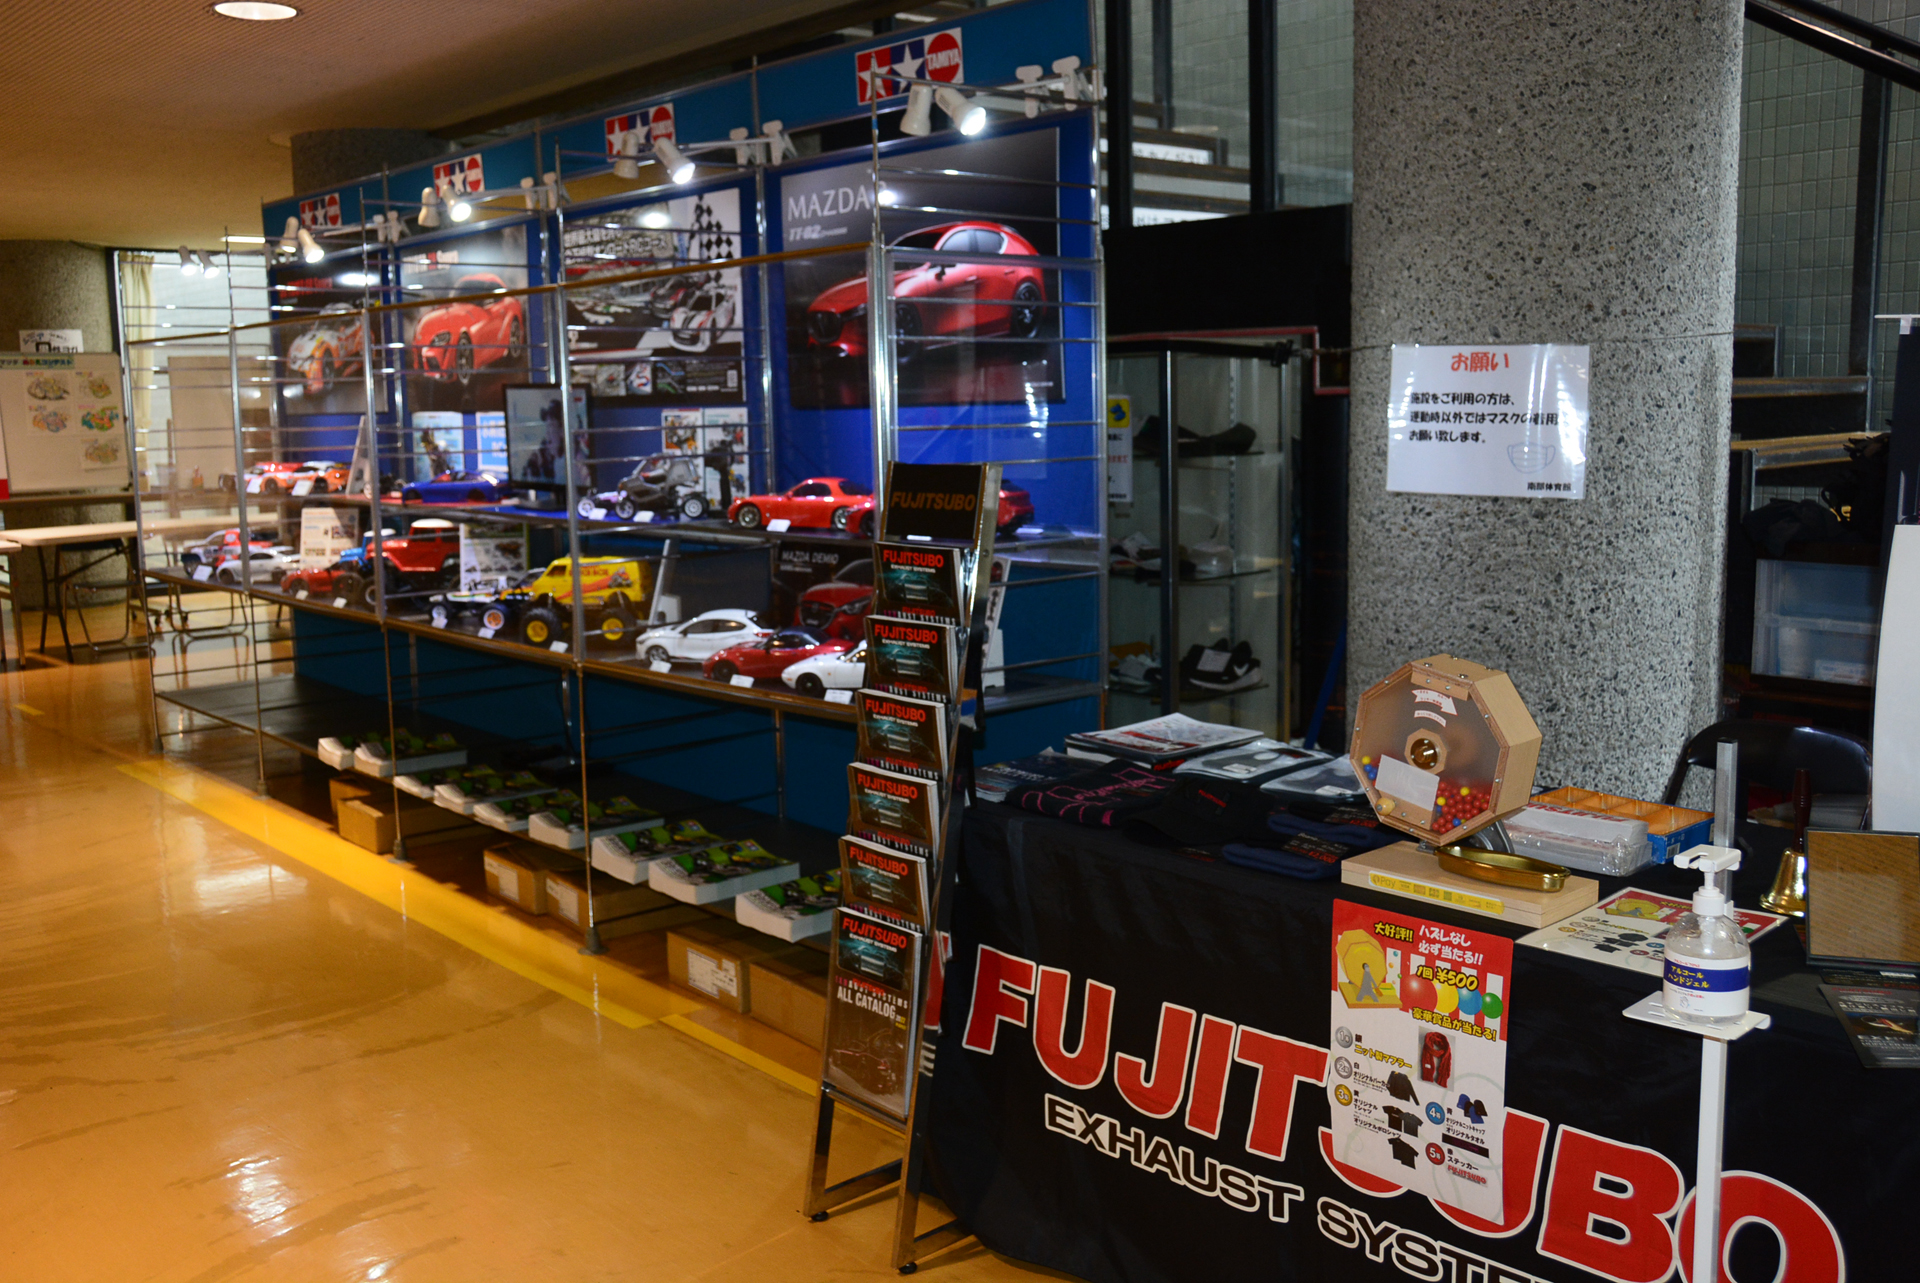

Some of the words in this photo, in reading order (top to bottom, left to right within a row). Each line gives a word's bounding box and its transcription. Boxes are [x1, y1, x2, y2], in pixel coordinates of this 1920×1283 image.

[926, 48, 960, 71] TAMIYA
[785, 183, 861, 217] MAZDA
[1451, 351, 1510, 372] お願い
[1411, 392, 1516, 406] 施設をご利用の方は、
[1410, 411, 1571, 426] 運動時以外ではマスクの着用
[1409, 430, 1486, 444] お願い致します。
[1527, 482, 1572, 491] 南部体育館
[890, 491, 977, 511] FUJITSUBO
[883, 549, 944, 568] FUJITSUBO
[874, 624, 938, 644] FUJITSUBO
[865, 698, 926, 722] FUJITSUBO
[857, 773, 918, 799] FUJITSUBO
[850, 846, 909, 876] FUJITSUBO
[842, 917, 907, 949] FUJITSUBO
[1374, 921, 1414, 942] 大好評!!
[1418, 940, 1484, 965] 必ず当たる!!
[1416, 964, 1433, 980] 1回
[1436, 967, 1479, 991] ¥500
[1668, 973, 1710, 988] ハンドジェル
[1671, 965, 1704, 979] アルコール
[837, 985, 853, 1004] ALL
[855, 992, 896, 1019] CATALOG
[1412, 1007, 1497, 1042] 豪華賞品が当たる!
[1354, 1044, 1412, 1069] ニット製マフラー
[962, 943, 1845, 1283] FUJITUBO
[1044, 1093, 1304, 1223] EXHAUST
[1447, 1155, 1479, 1171] ステッカー
[1447, 1164, 1487, 1184] FUJITSUBO
